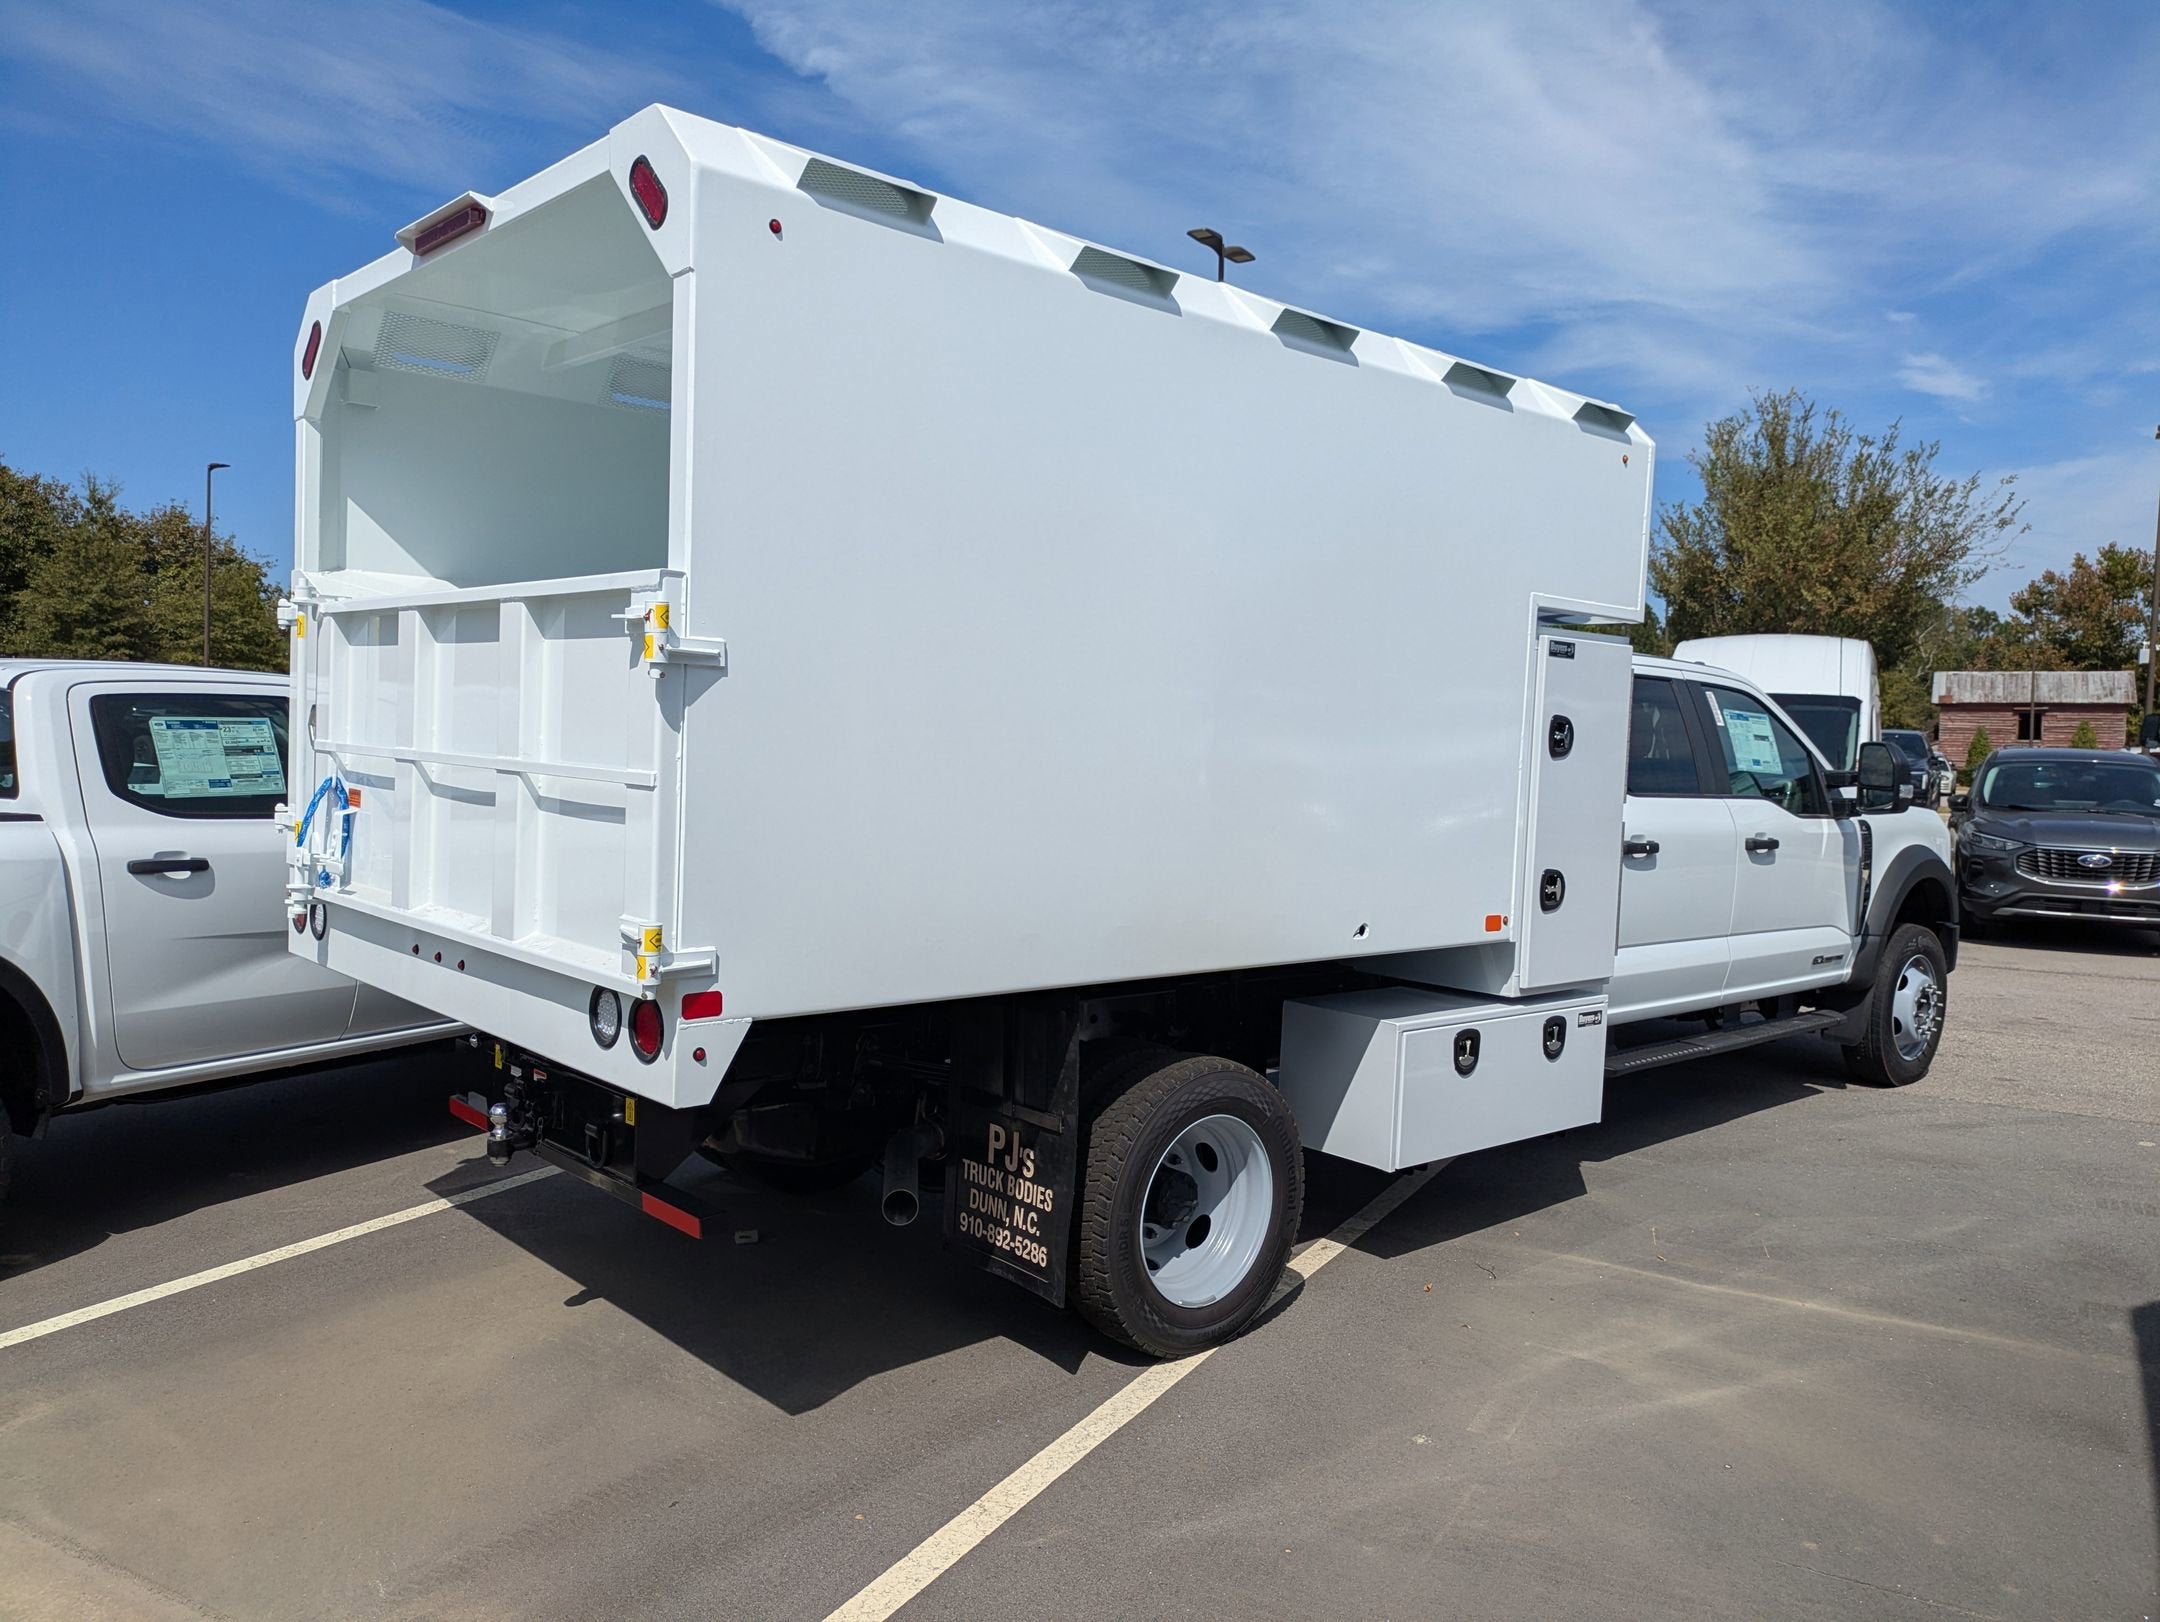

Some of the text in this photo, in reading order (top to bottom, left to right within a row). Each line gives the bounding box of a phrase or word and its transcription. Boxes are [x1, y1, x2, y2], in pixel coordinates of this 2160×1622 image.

[962, 1158, 1053, 1212] TRUCK BODIES
[969, 1188, 1040, 1237] DUNN, N.C.
[959, 1212, 1048, 1268] 910-892-5286
